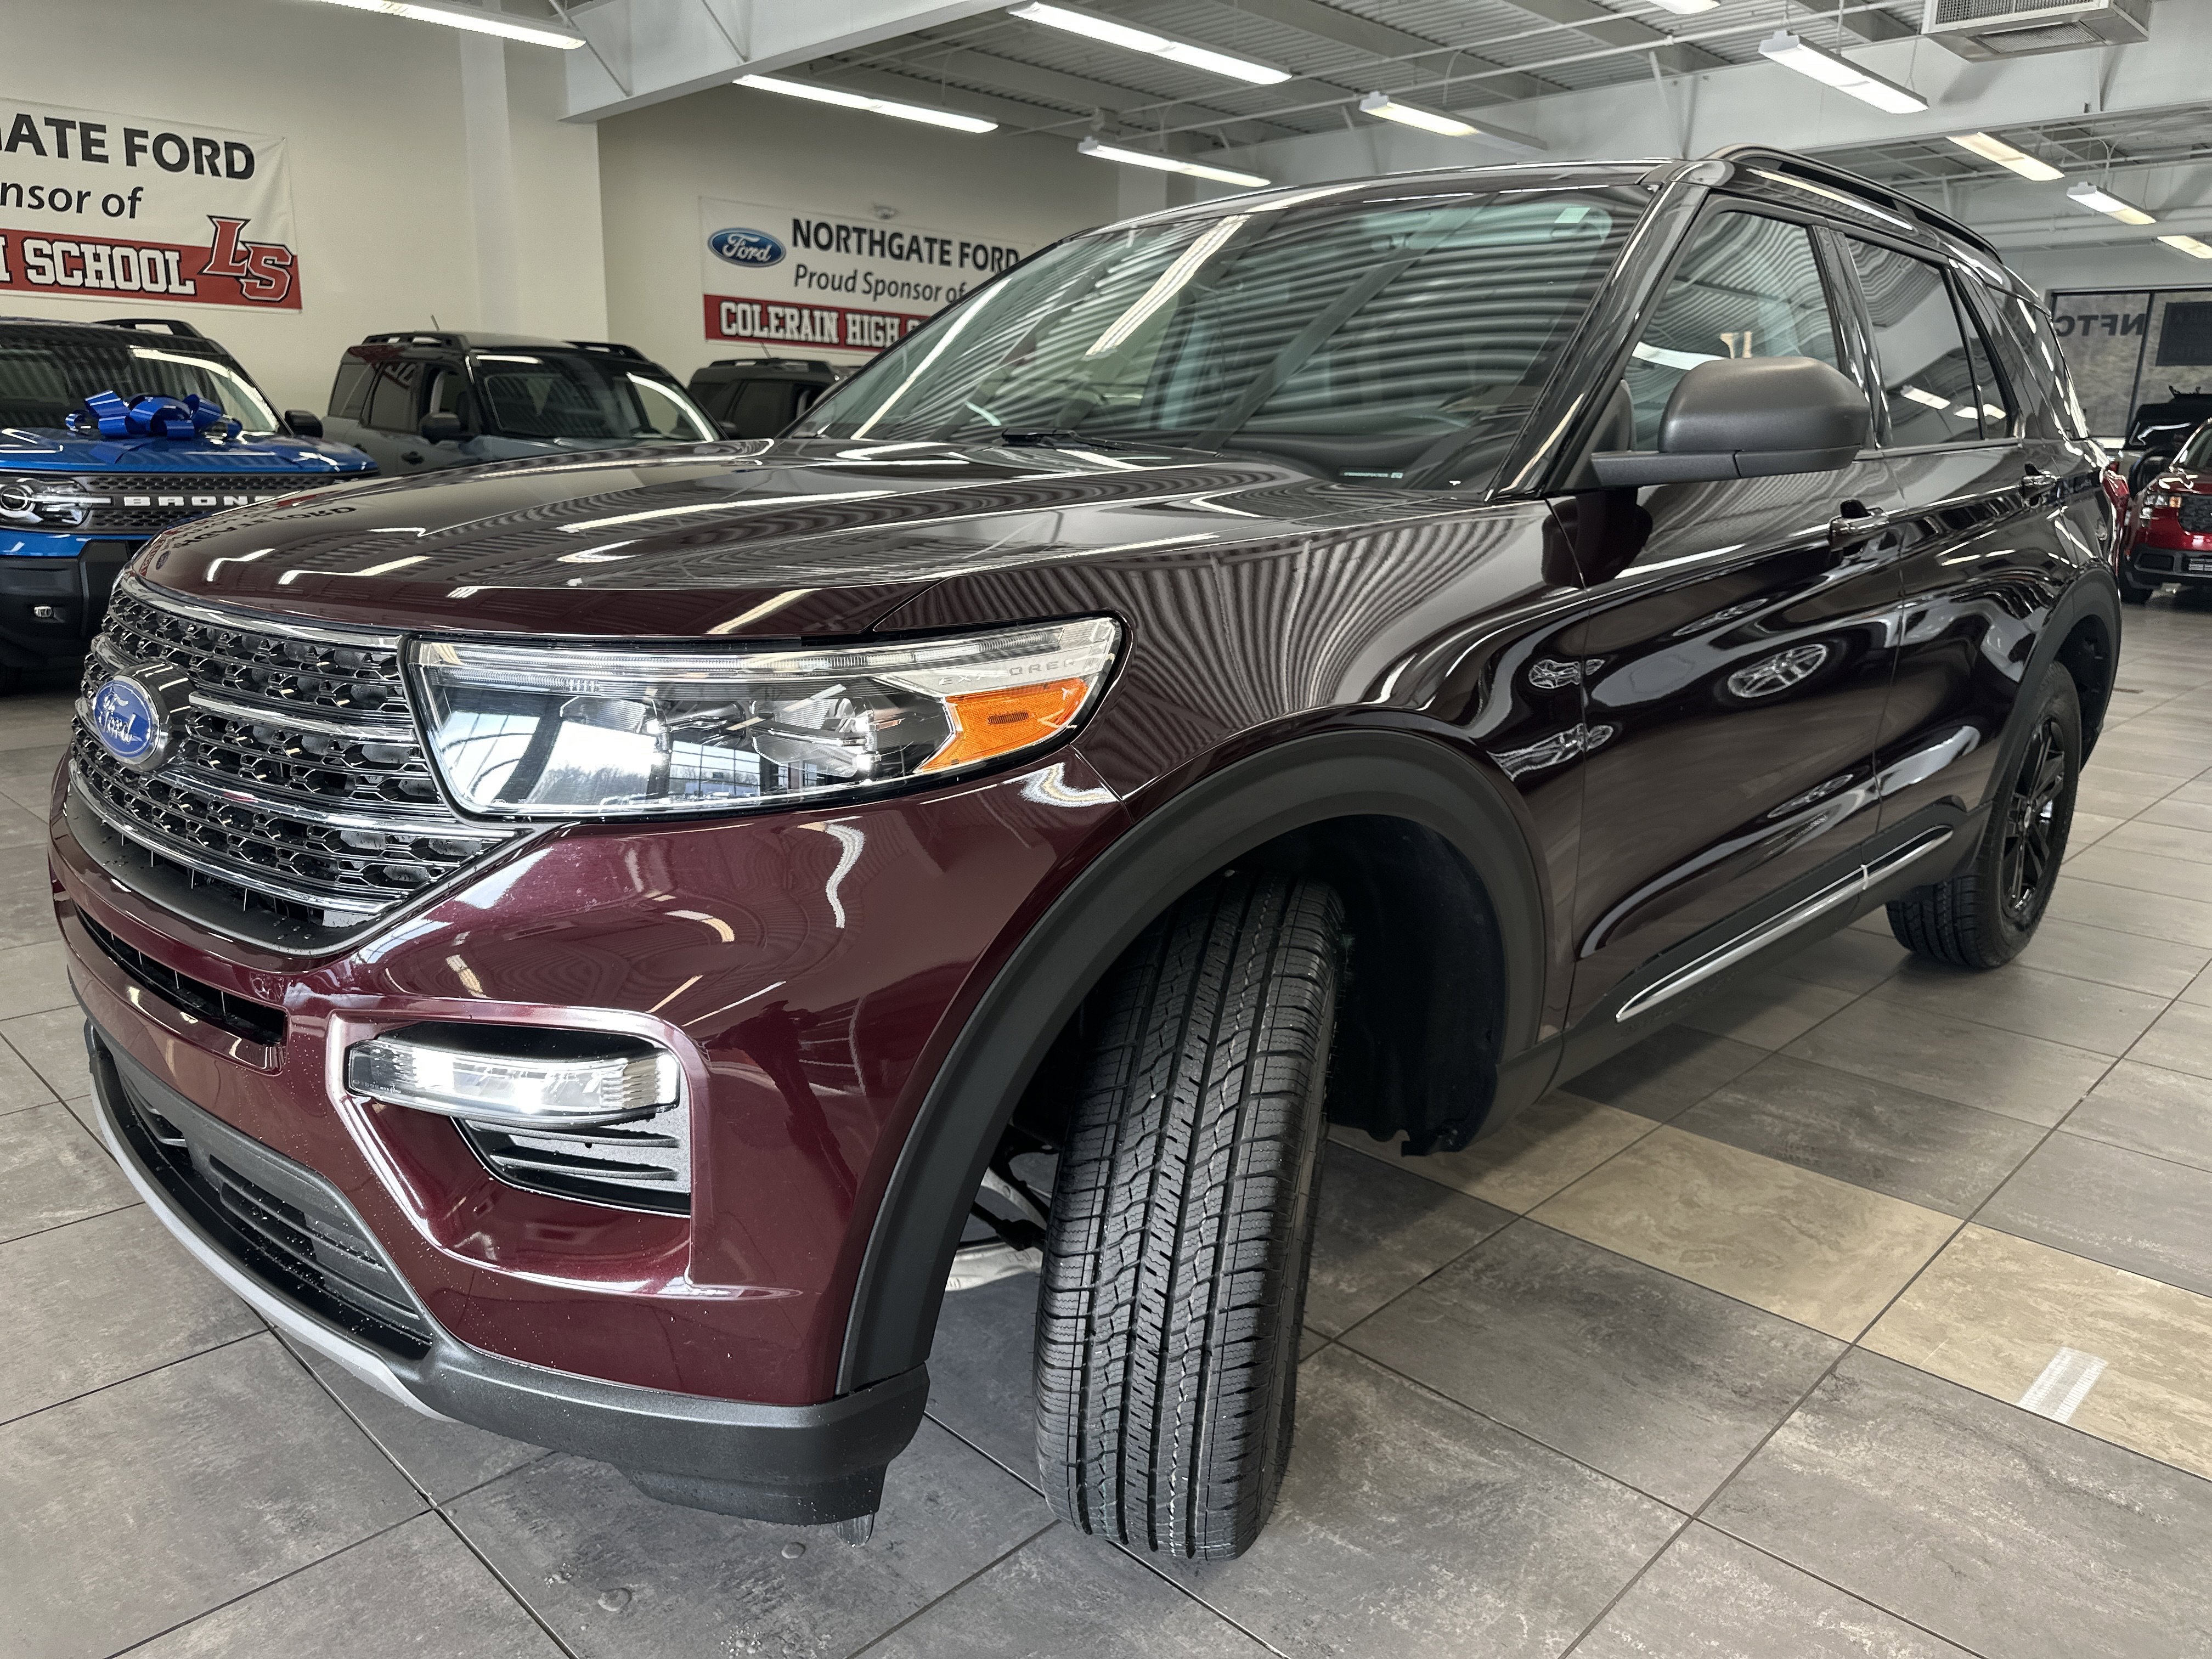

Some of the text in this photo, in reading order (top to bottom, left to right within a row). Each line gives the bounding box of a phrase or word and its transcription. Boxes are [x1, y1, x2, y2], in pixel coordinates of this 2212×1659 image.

[0, 113, 255, 180] ATE FORD
[0, 182, 144, 219] nsor of
[22, 238, 198, 296] SCHOOL
[198, 215, 293, 302] LS
[720, 232, 774, 263] Ford
[791, 218, 1019, 273] NORTHGATE FORD
[794, 264, 967, 303] Proud Sponsor of
[719, 301, 901, 348] COLERAIN HIGH
[97, 684, 145, 747] Ford
